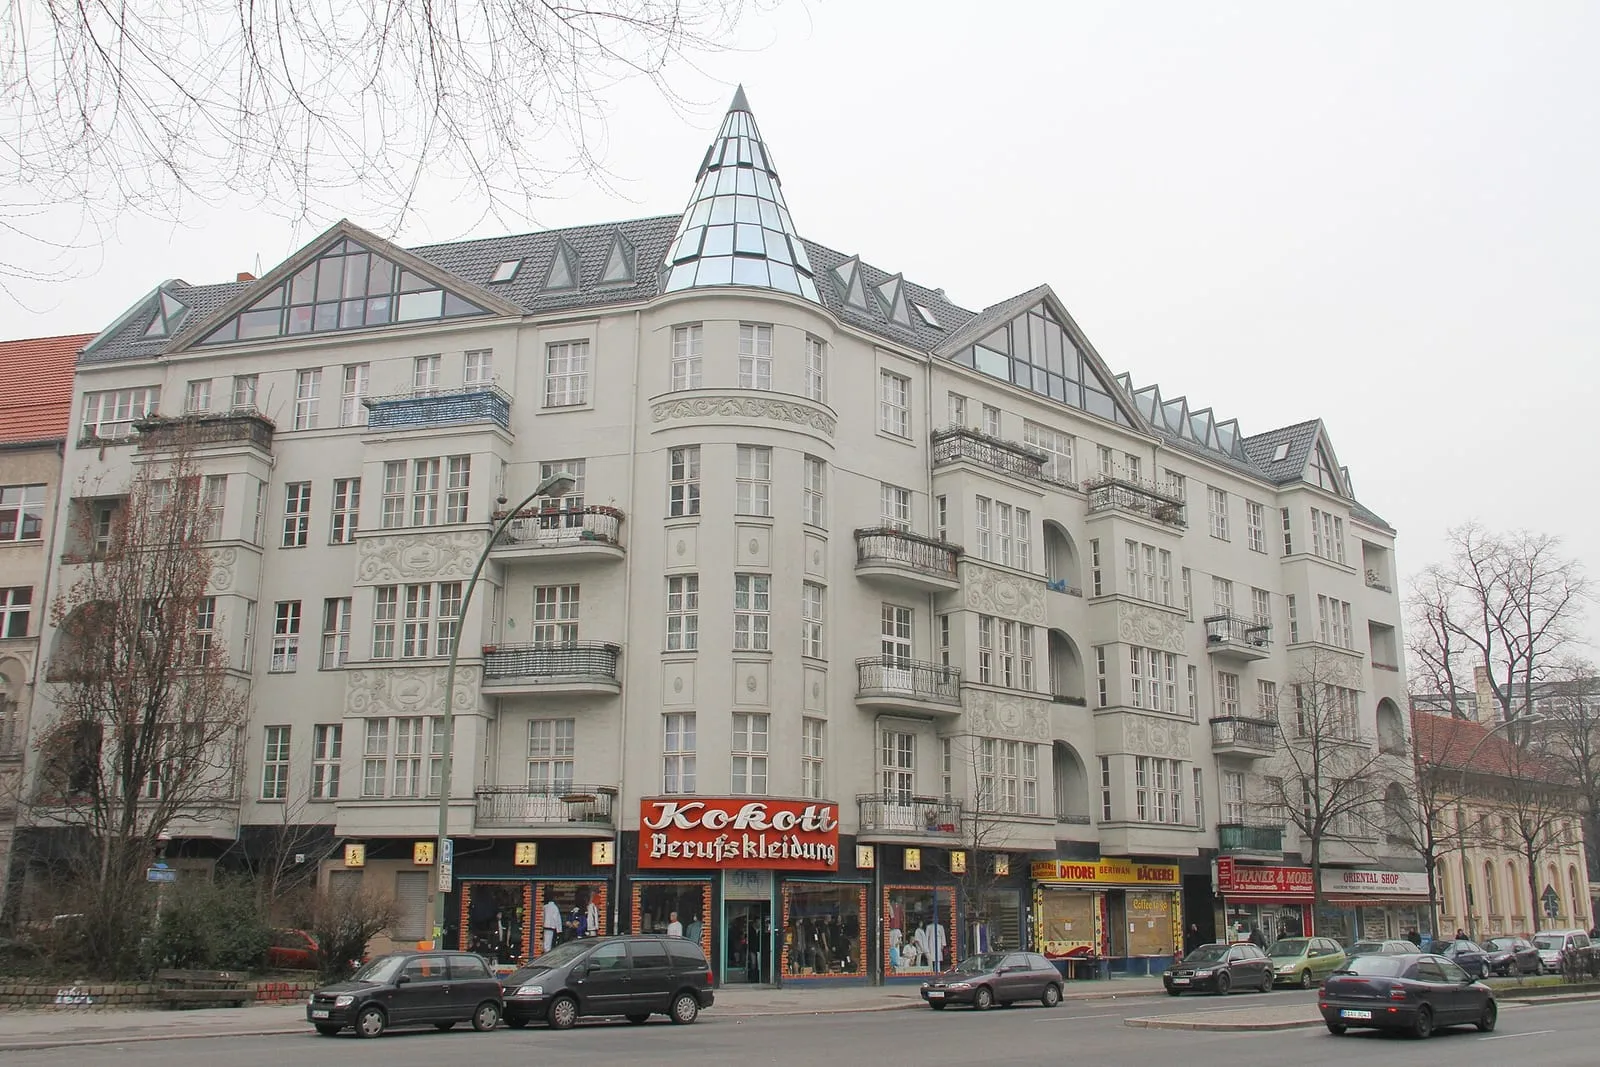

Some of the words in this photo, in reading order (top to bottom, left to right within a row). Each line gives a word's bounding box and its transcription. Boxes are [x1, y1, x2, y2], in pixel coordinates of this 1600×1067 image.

[643, 801, 838, 833] Kokott
[649, 832, 836, 866] Berufskleidung
[1137, 866, 1174, 881] BÄCKEREI
[1343, 872, 1378, 883] ORIENTAL
[1381, 873, 1399, 885] SHOP
